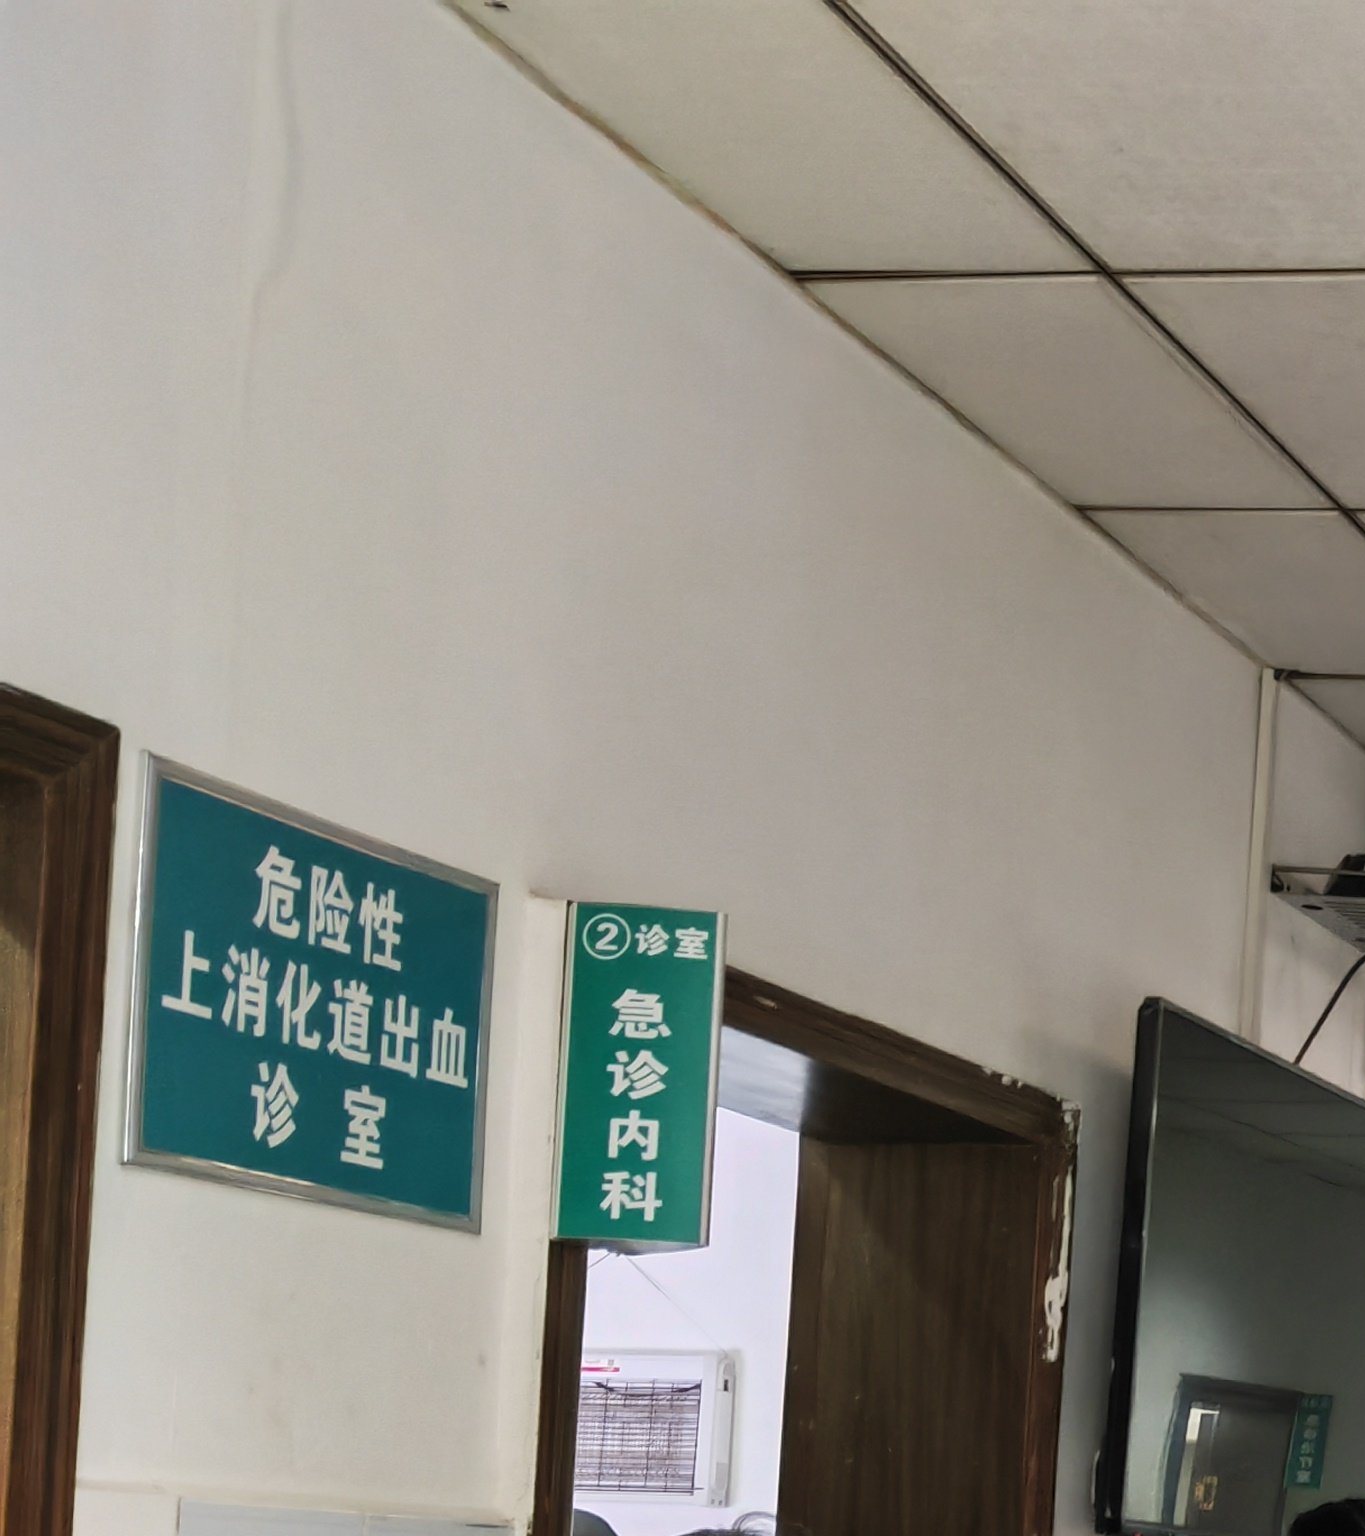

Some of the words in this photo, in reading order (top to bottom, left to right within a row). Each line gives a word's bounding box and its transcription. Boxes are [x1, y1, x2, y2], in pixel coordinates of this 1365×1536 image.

[253, 845, 404, 972] 危险性
[161, 930, 469, 1089] 上消化道出血
[599, 987, 673, 1223] 急诊内科
